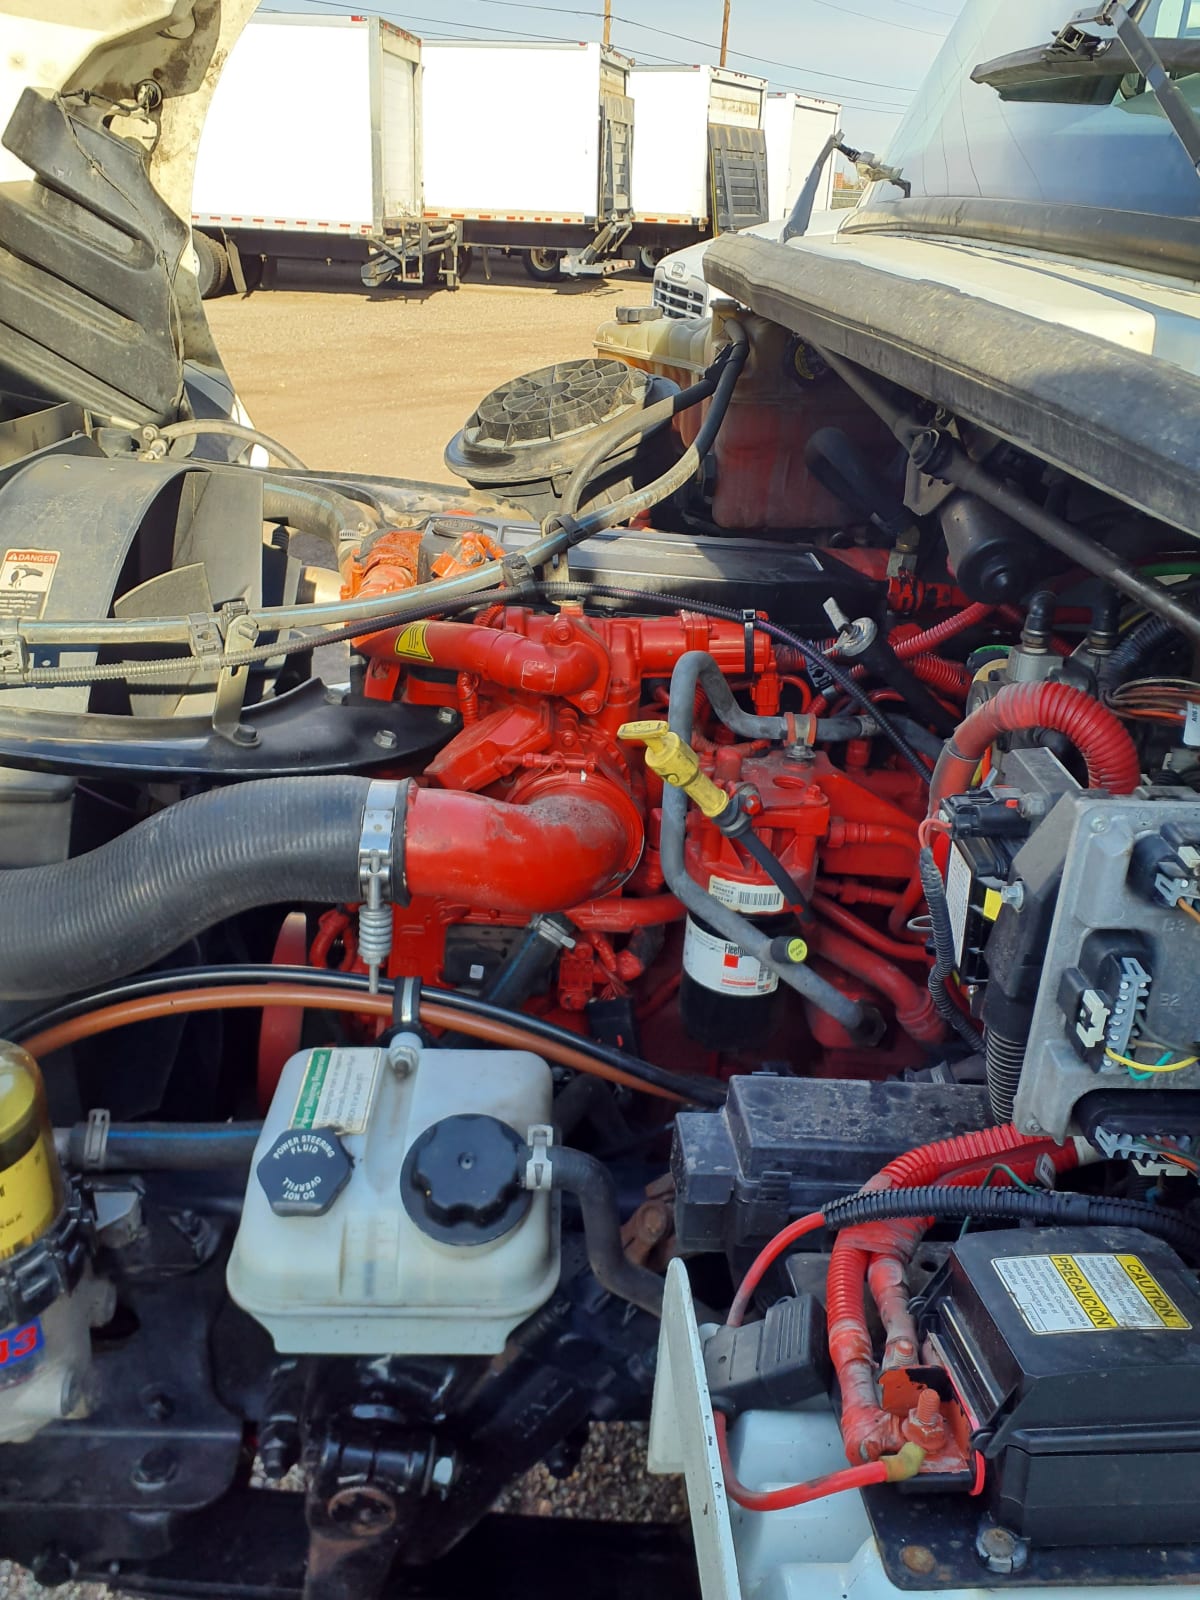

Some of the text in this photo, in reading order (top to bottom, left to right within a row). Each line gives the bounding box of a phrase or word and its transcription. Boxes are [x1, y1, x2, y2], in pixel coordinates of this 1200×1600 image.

[18, 553, 57, 563] DANGER
[273, 1135, 336, 1159] POWER STEERING
[290, 1144, 319, 1155] FLUID
[282, 1175, 322, 1192] OVERFILL
[283, 1190, 316, 1200] DO NOT
[1053, 1256, 1113, 1327] PRECAUCIÓN
[1126, 1263, 1178, 1318] CAUTION
